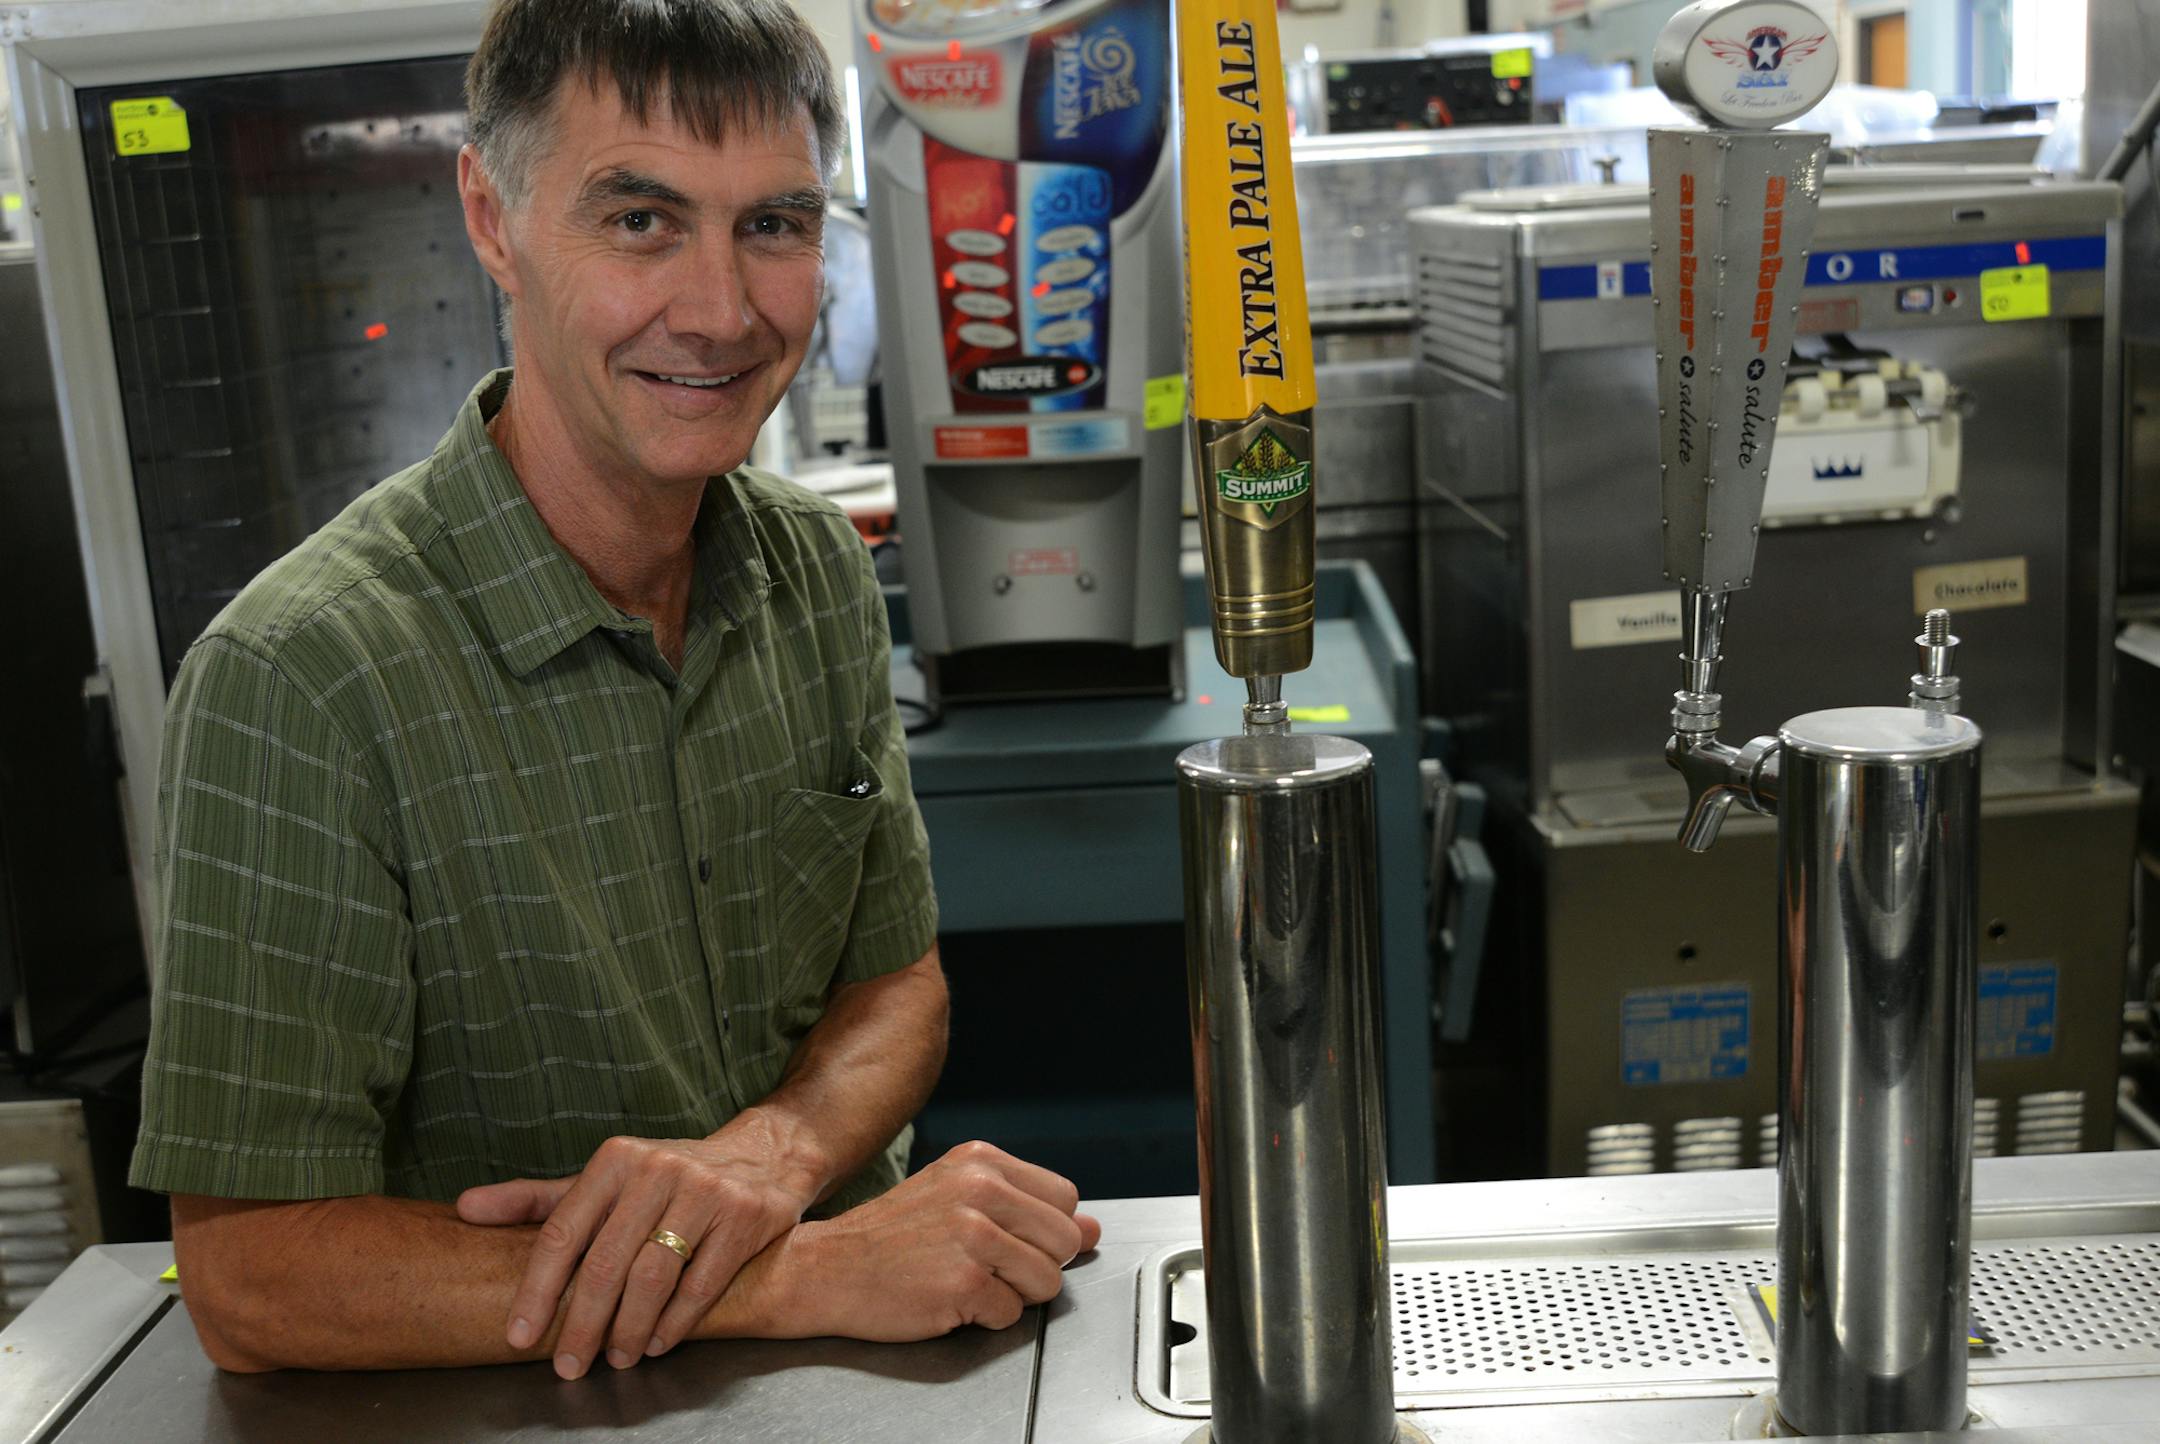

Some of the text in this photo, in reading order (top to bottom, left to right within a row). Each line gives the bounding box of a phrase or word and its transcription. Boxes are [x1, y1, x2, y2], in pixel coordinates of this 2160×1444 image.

[1217, 20, 1285, 381] EXTRA PALE ALE
[1679, 174, 1698, 466] amber salute
[1738, 176, 1787, 469] amber salute
[1225, 472, 1304, 497] SUMMIT
